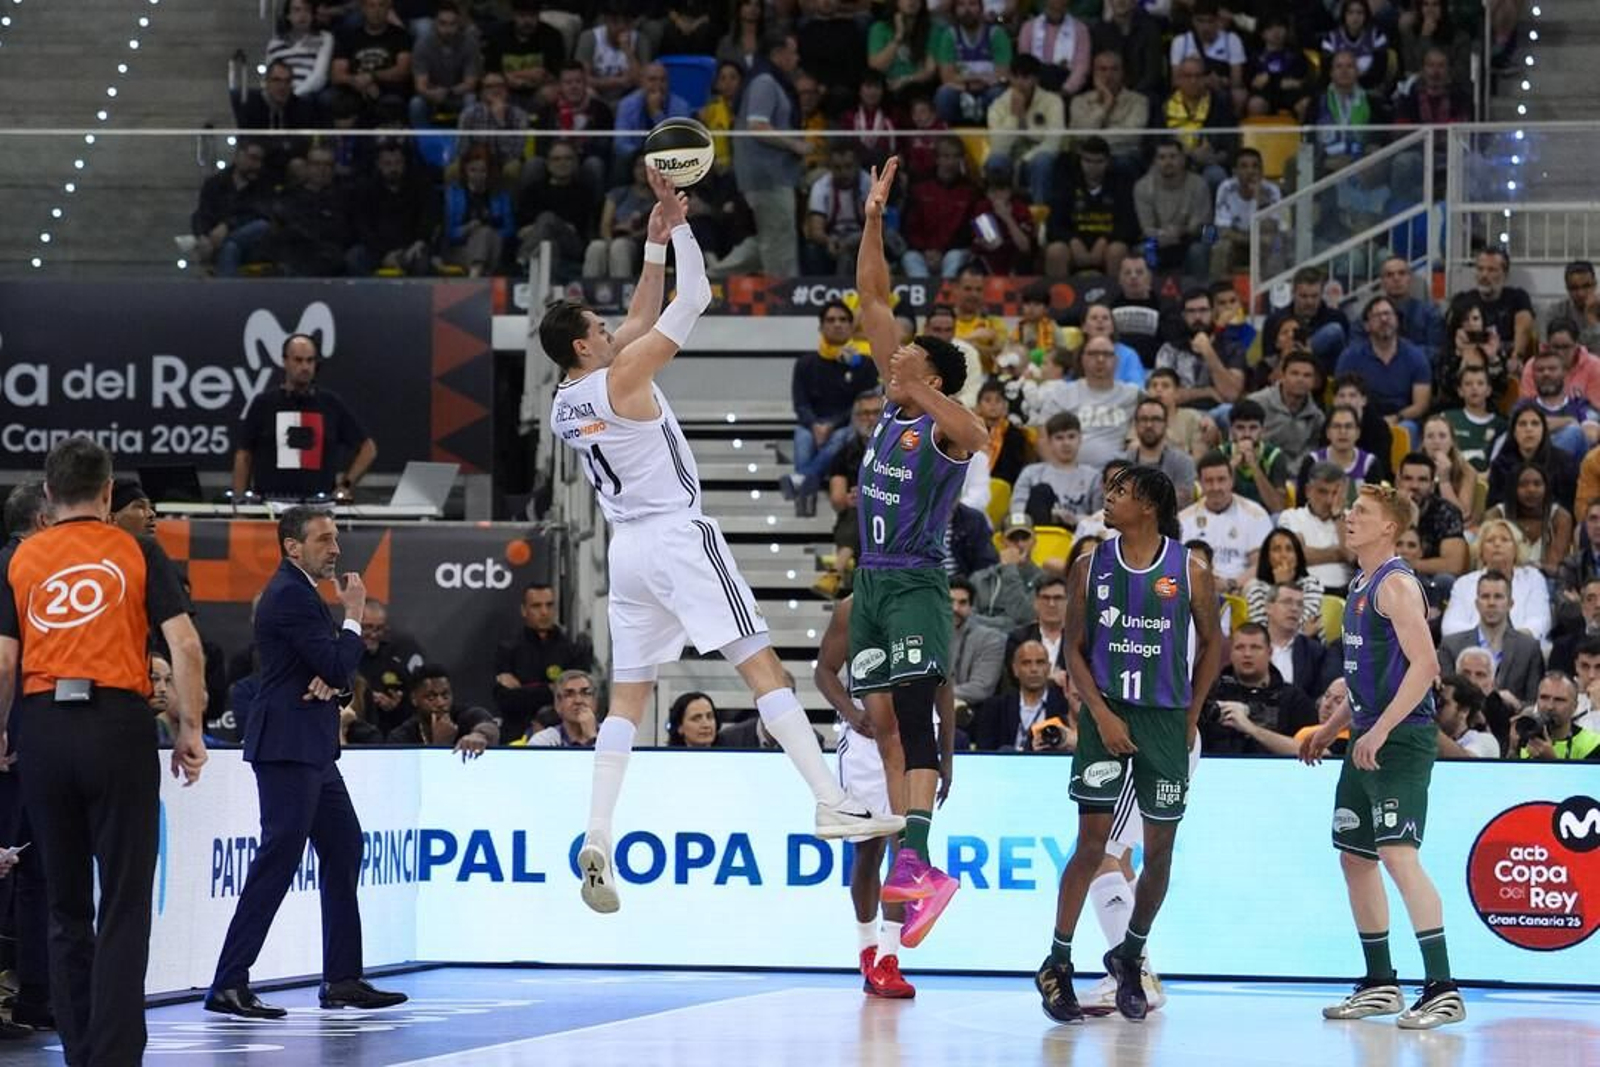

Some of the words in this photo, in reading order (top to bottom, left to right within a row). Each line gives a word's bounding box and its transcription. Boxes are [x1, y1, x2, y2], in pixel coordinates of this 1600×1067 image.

[654, 157, 699, 170] Wilson
[62, 363, 136, 400] del
[152, 355, 273, 420] Rey
[151, 425, 229, 453] 2025
[873, 460, 913, 481] Unicaja
[873, 515, 885, 544] 0
[435, 557, 513, 589] acb
[46, 578, 103, 614] 20
[1122, 615, 1171, 633] Unicaja
[1120, 671, 1142, 700] 11
[360, 829, 545, 887] PRINCIPAL
[1510, 845, 1548, 861] acb
[1494, 861, 1568, 886] Copa
[1499, 886, 1526, 899] del
[1530, 887, 1578, 914] Rey
[1488, 914, 1517, 925] Gran
[1518, 915, 1564, 926] Canaria
